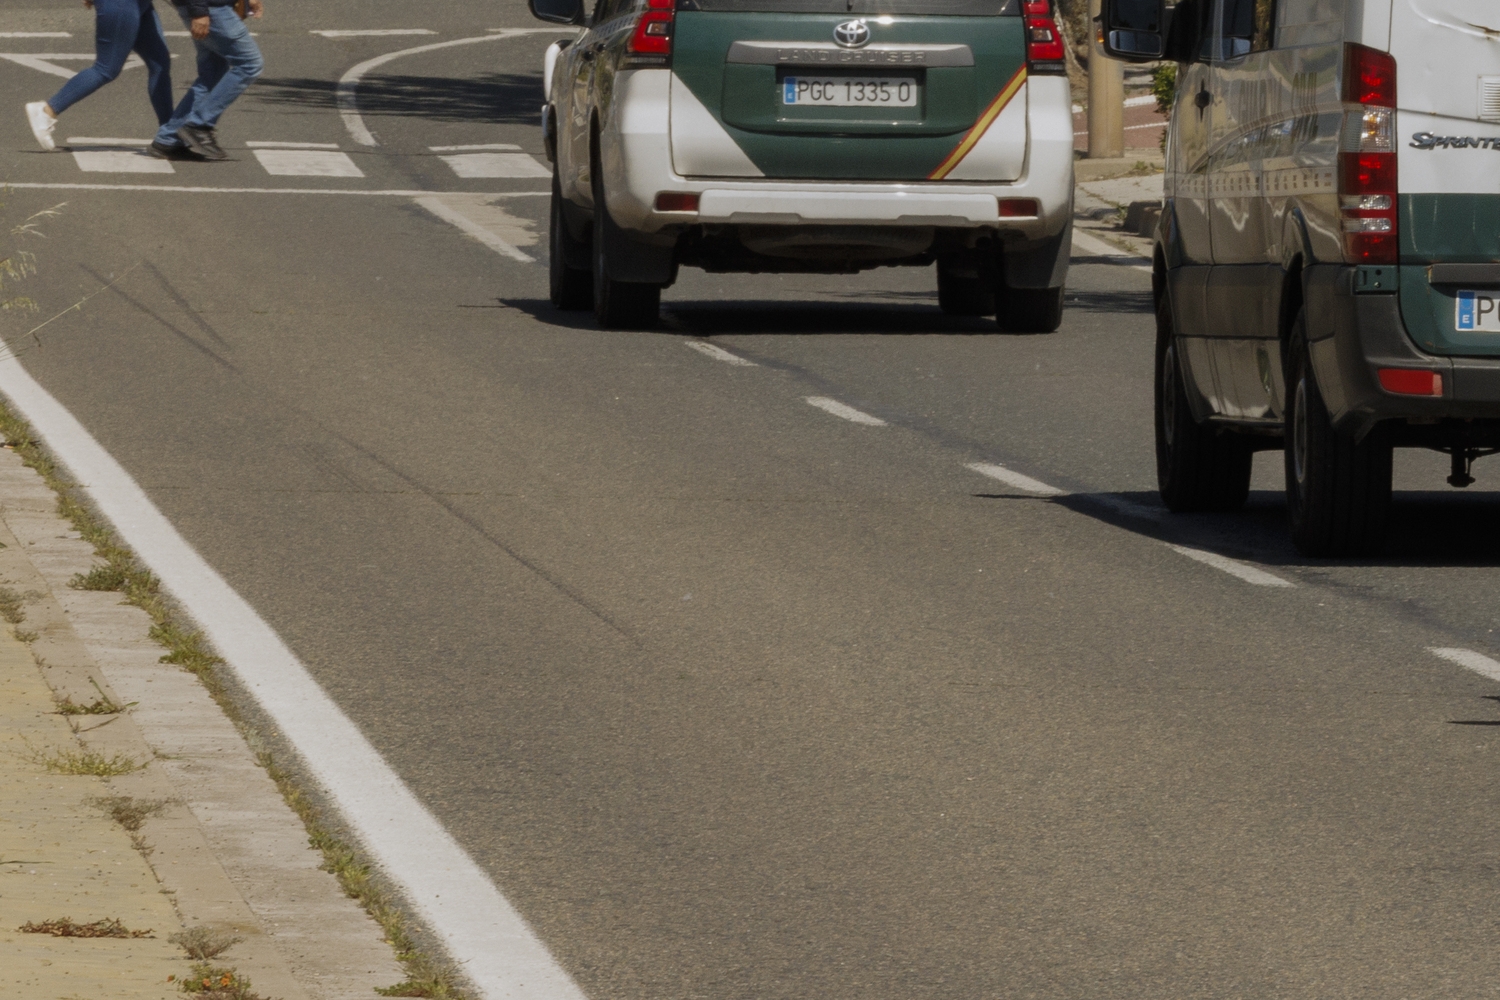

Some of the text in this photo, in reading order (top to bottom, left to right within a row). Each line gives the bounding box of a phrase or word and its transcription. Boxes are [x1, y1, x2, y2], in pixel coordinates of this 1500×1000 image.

[778, 49, 926, 63] LAND CRUISER
[797, 80, 835, 101] PGC
[844, 81, 891, 102] 1335
[1462, 314, 1470, 324] E
